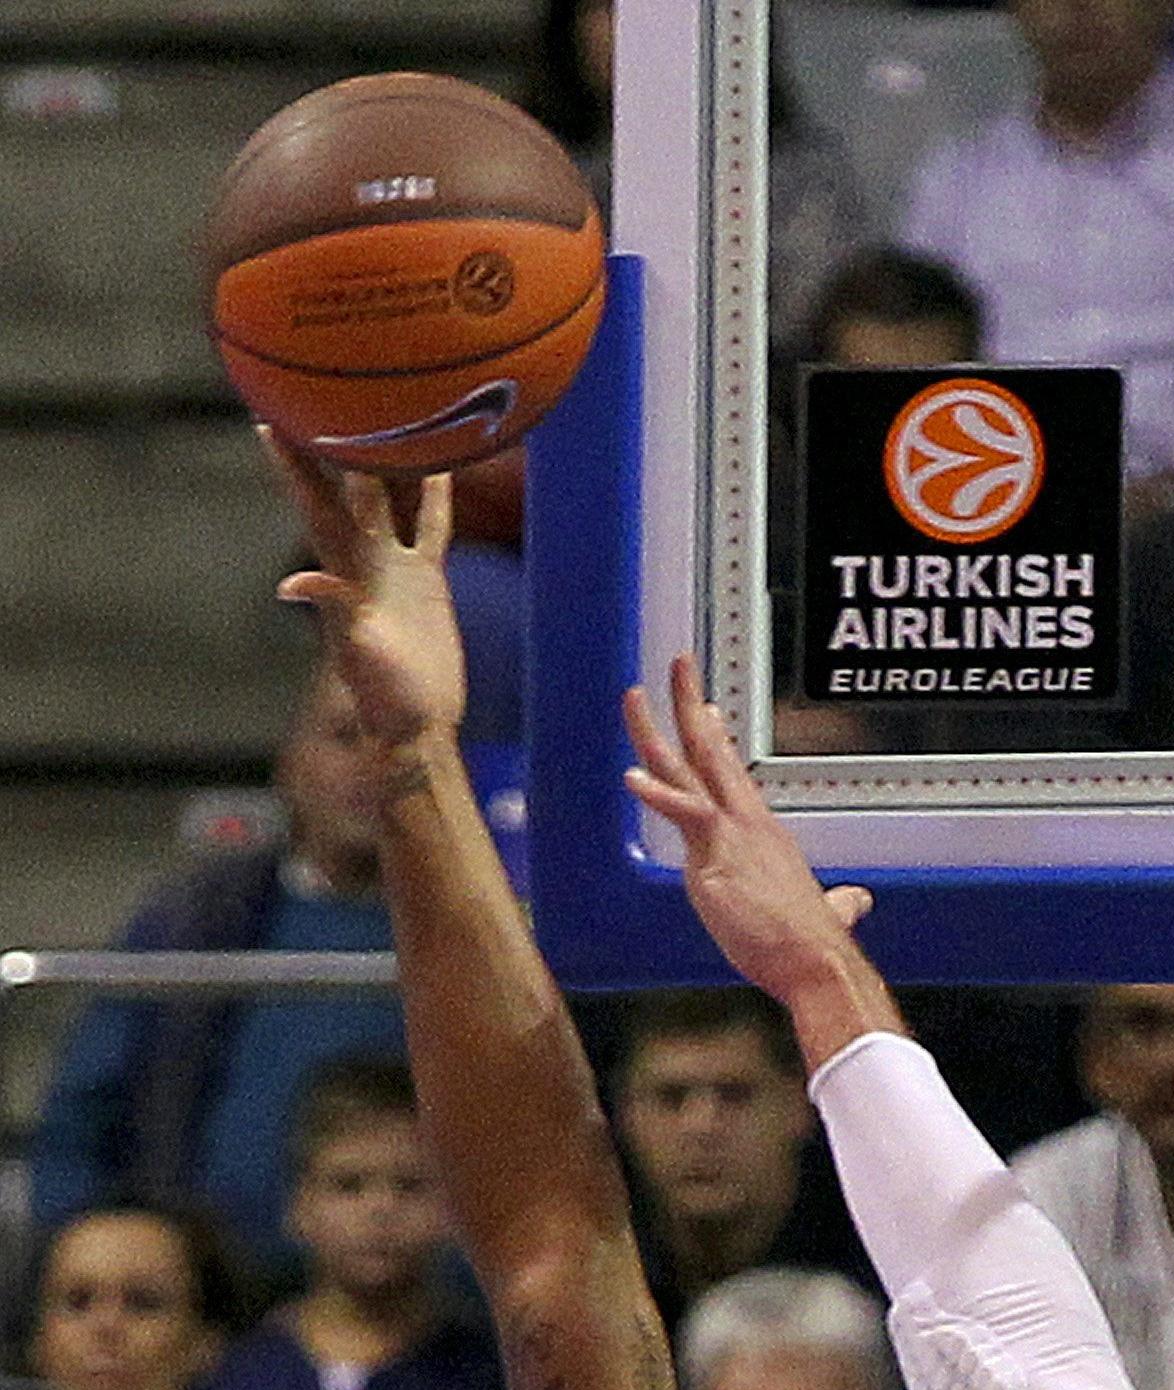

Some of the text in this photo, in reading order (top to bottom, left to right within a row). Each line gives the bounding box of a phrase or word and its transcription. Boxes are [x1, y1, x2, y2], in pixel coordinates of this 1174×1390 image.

[831, 554, 1095, 598] TURKISH
[828, 605, 1096, 650] AIRLINES
[829, 667, 1095, 692] EUROLEAGUE
